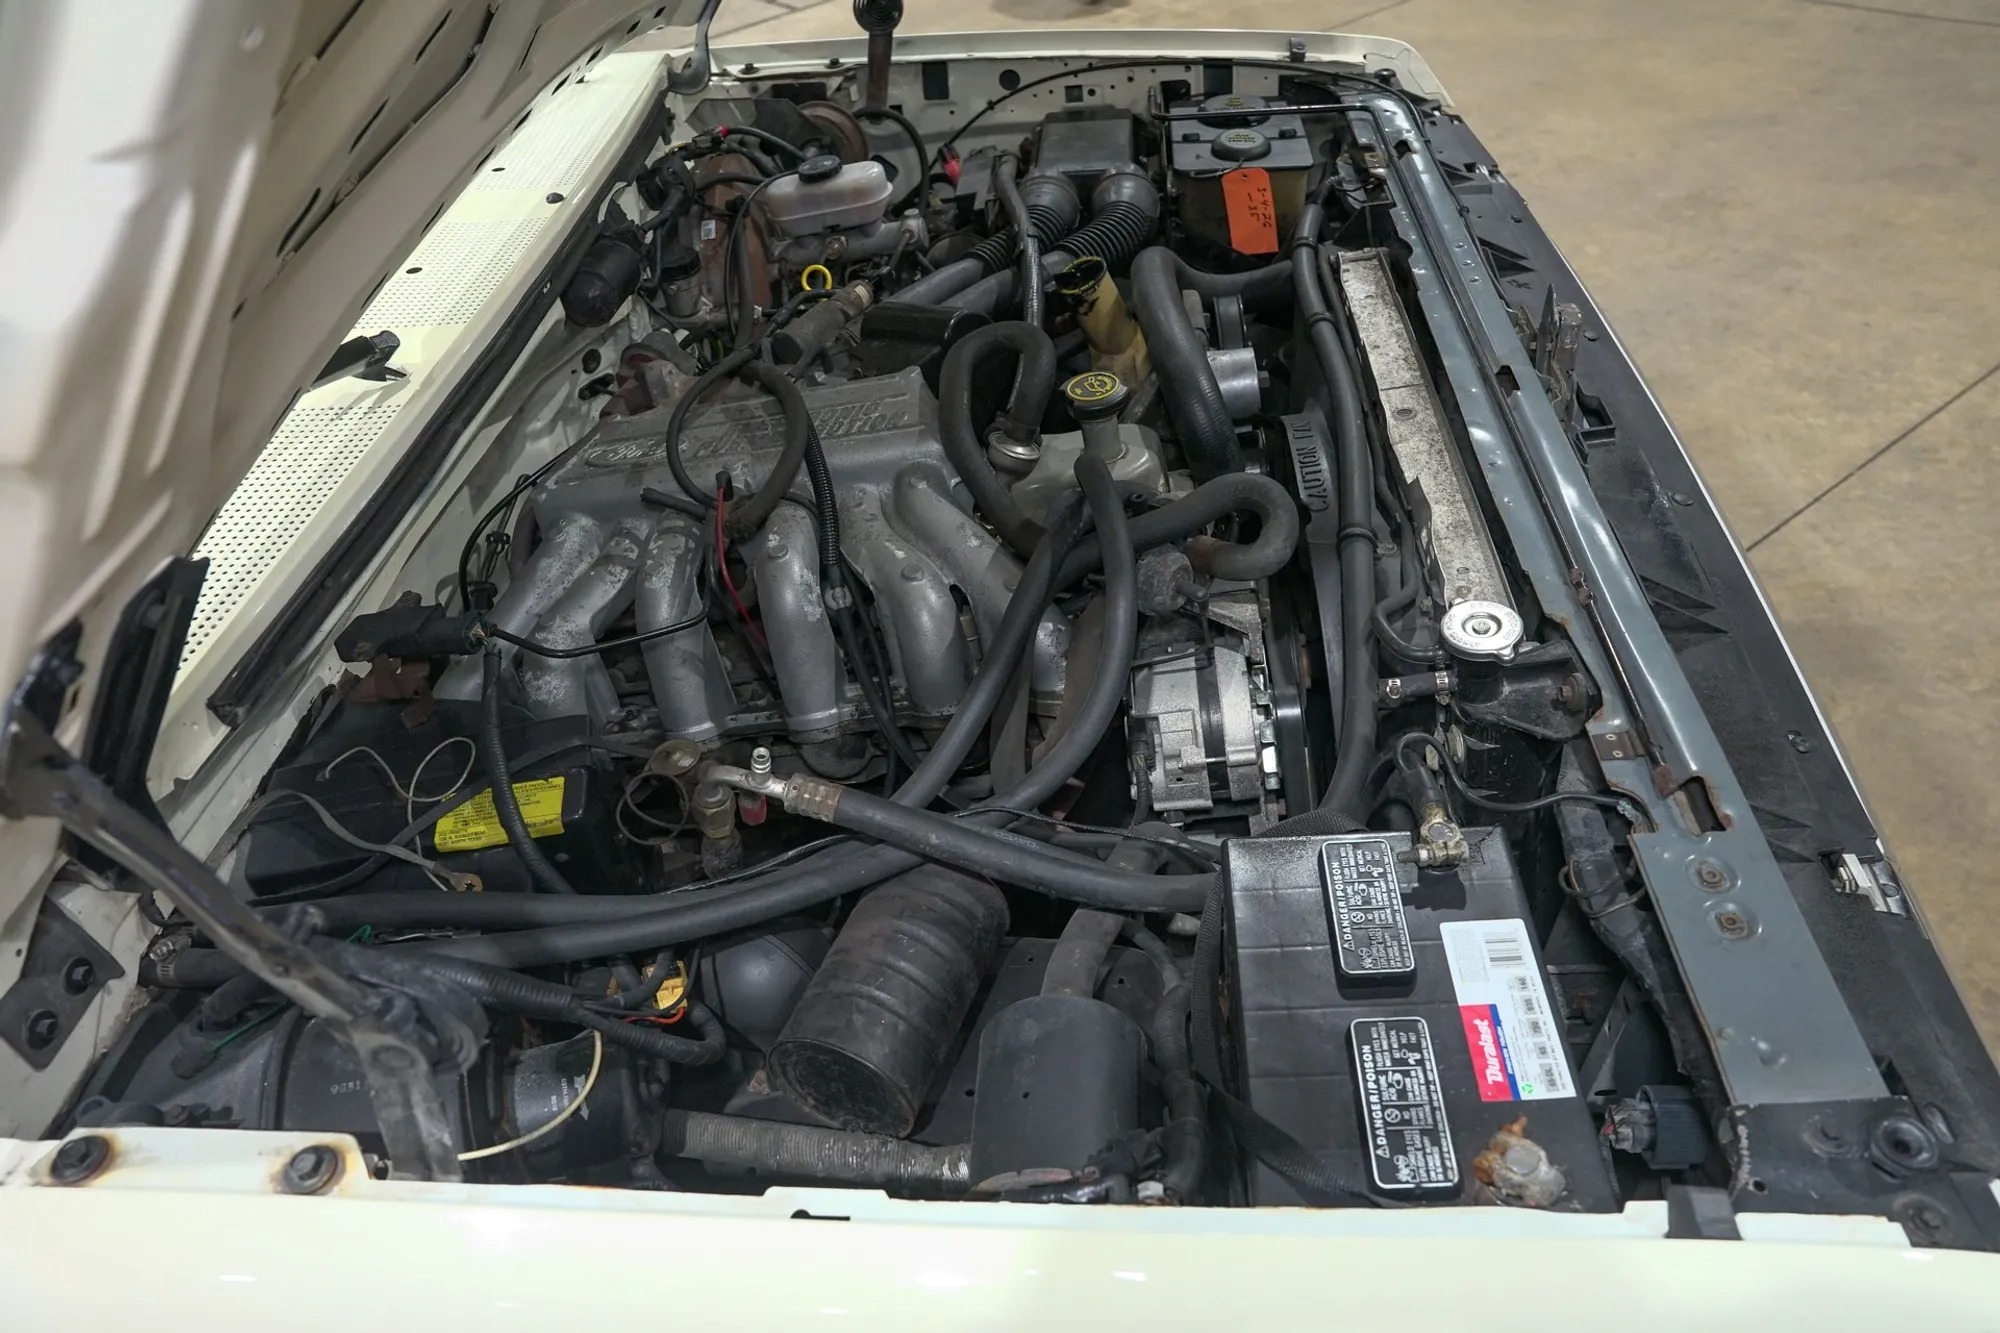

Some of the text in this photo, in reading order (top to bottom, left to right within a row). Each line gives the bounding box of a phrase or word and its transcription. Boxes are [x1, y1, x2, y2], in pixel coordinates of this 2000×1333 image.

[1291, 422, 1329, 512] CAUTION FAN
[1332, 862, 1352, 940] DANGER/POISON
[1399, 1032, 1407, 1044] HELP
[1473, 1019, 1504, 1084] Duralast
[1362, 1044, 1387, 1145] DANGER/POISON
